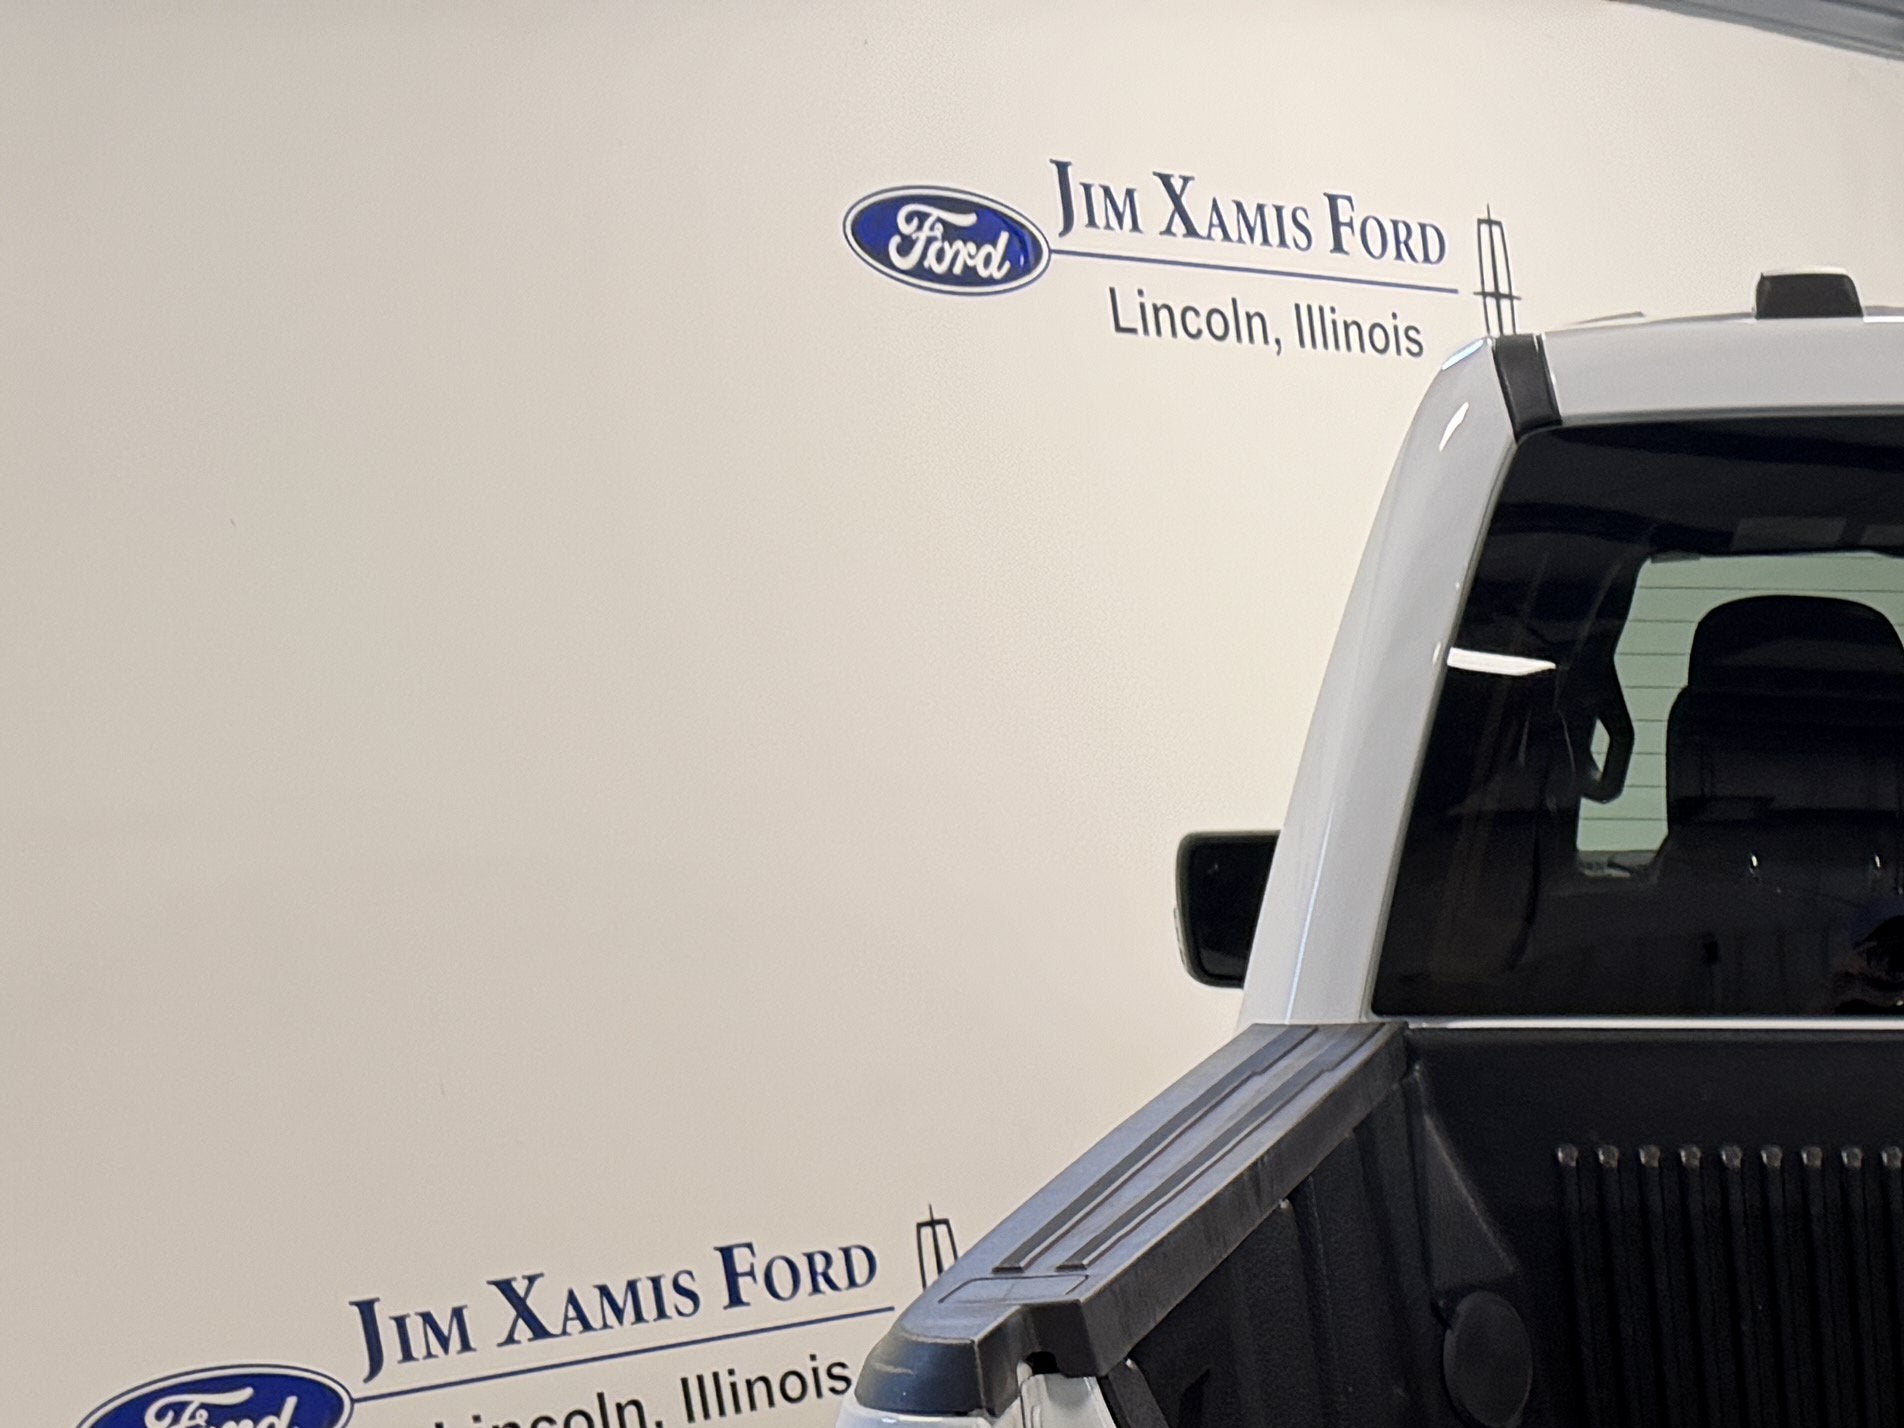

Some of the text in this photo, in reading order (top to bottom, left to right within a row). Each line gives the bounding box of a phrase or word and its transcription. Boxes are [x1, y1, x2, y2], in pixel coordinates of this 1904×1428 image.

[887, 202, 1012, 281] Ford
[1049, 158, 1446, 265] JIM XAMIS FORD
[1108, 286, 1425, 358] Lincoln, Illinois
[349, 1241, 878, 1384] JIM XAMIS FORD
[680, 1356, 853, 1424] Illinois
